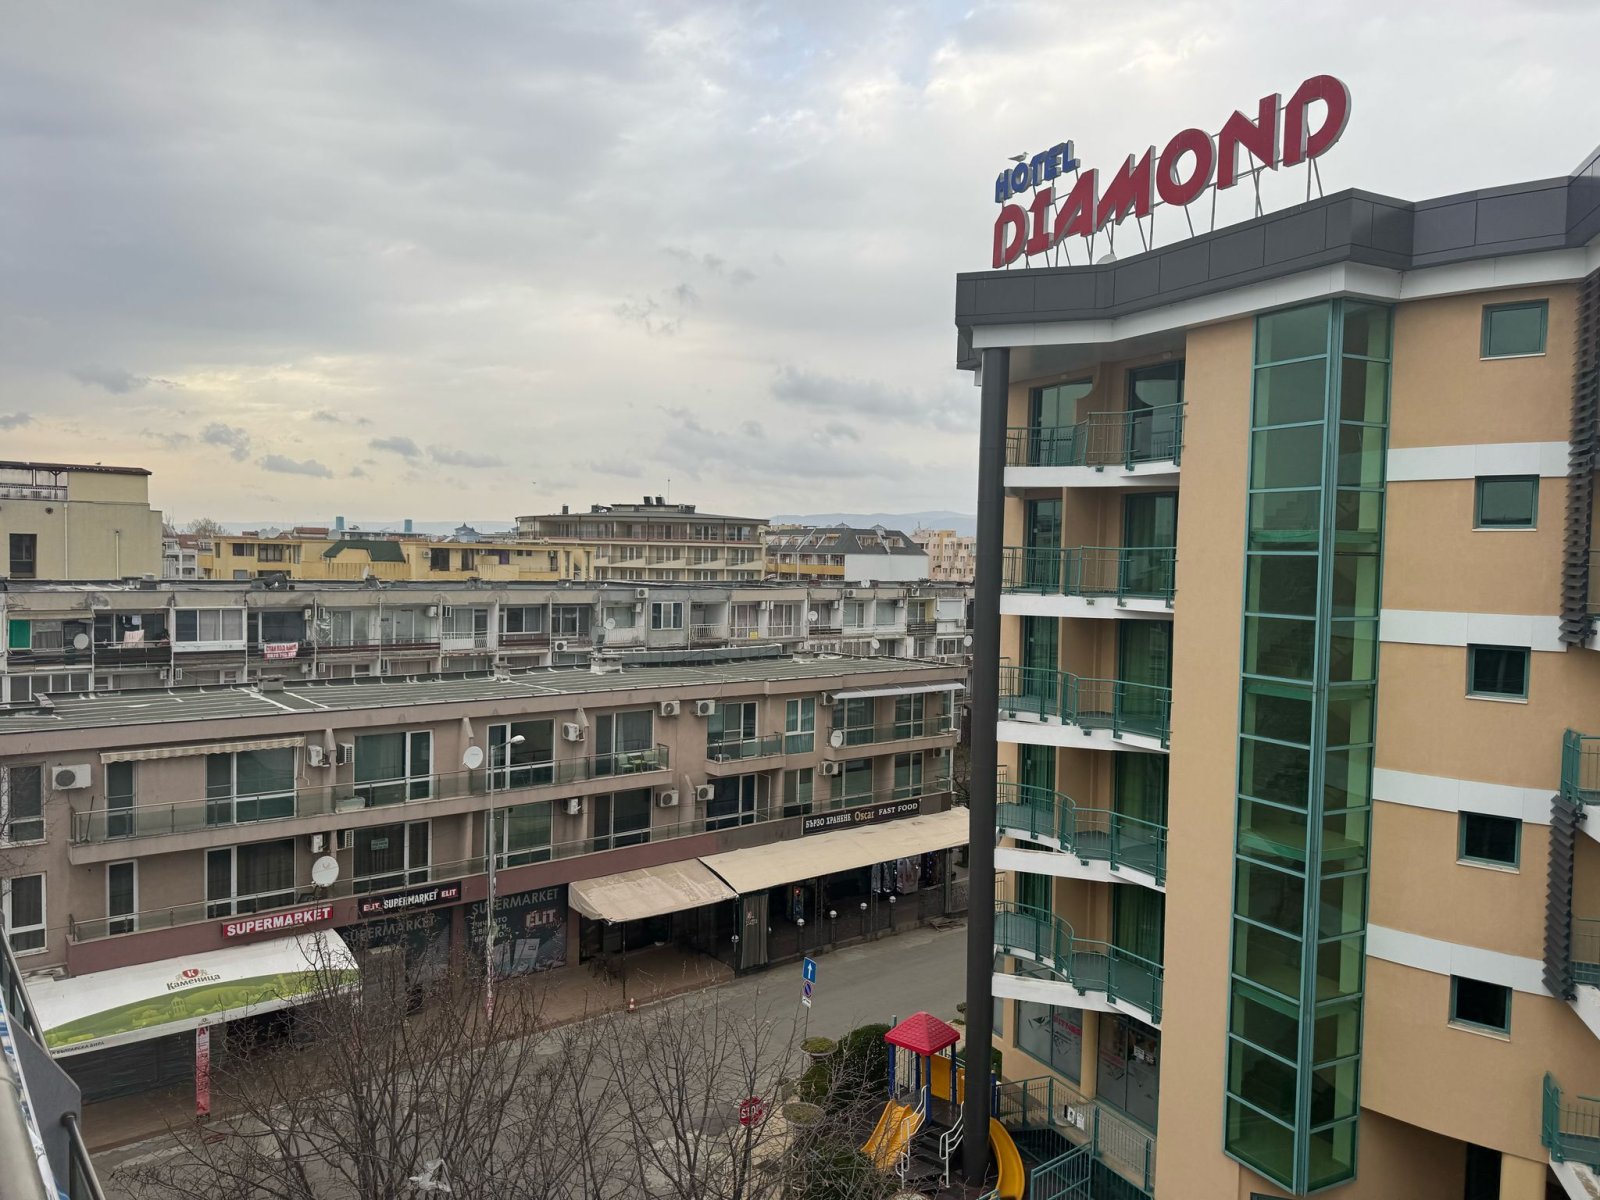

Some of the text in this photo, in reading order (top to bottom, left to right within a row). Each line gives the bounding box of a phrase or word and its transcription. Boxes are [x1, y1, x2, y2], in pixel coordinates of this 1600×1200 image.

[992, 74, 1352, 268] DIAMOND
[995, 140, 1080, 203] HOTEL
[805, 802, 918, 829] БЪРЗО ХРАНЕНЕ Oscar FAST FOOD
[383, 891, 438, 910] SUPERMARKET
[471, 888, 559, 916] SUERMARKET
[226, 907, 331, 937] SUPERMARKET
[166, 974, 221, 990] Каменица
